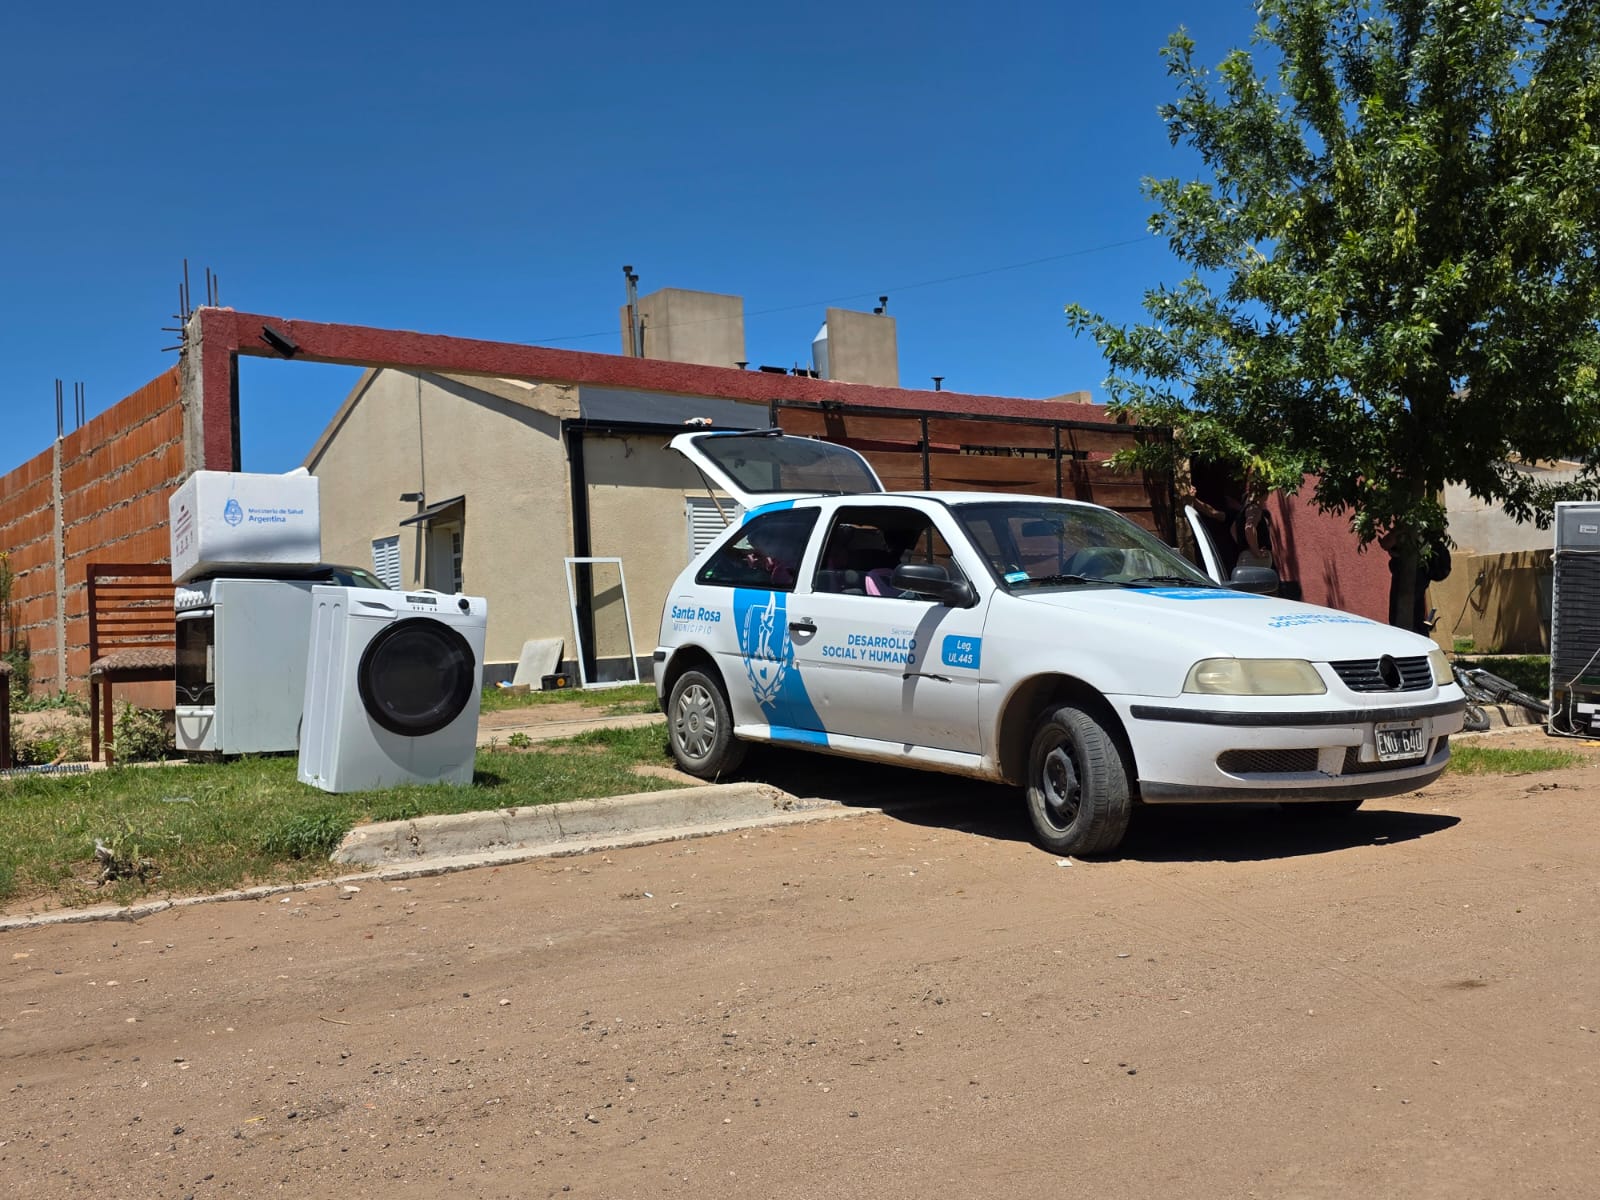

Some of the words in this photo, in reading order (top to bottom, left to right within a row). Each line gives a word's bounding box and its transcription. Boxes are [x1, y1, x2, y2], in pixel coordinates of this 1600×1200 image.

[248, 515, 286, 524] Argentina
[672, 606, 695, 620] Santa
[697, 607, 721, 622] Rosa
[673, 623, 712, 634] MUNICIPIO
[848, 634, 917, 650] DESARROLLO
[957, 639, 973, 652] Leg.
[822, 646, 857, 660] SOCIAL
[860, 649, 866, 660] Y
[869, 650, 916, 664] HUMANO
[1401, 729, 1423, 752] 640
